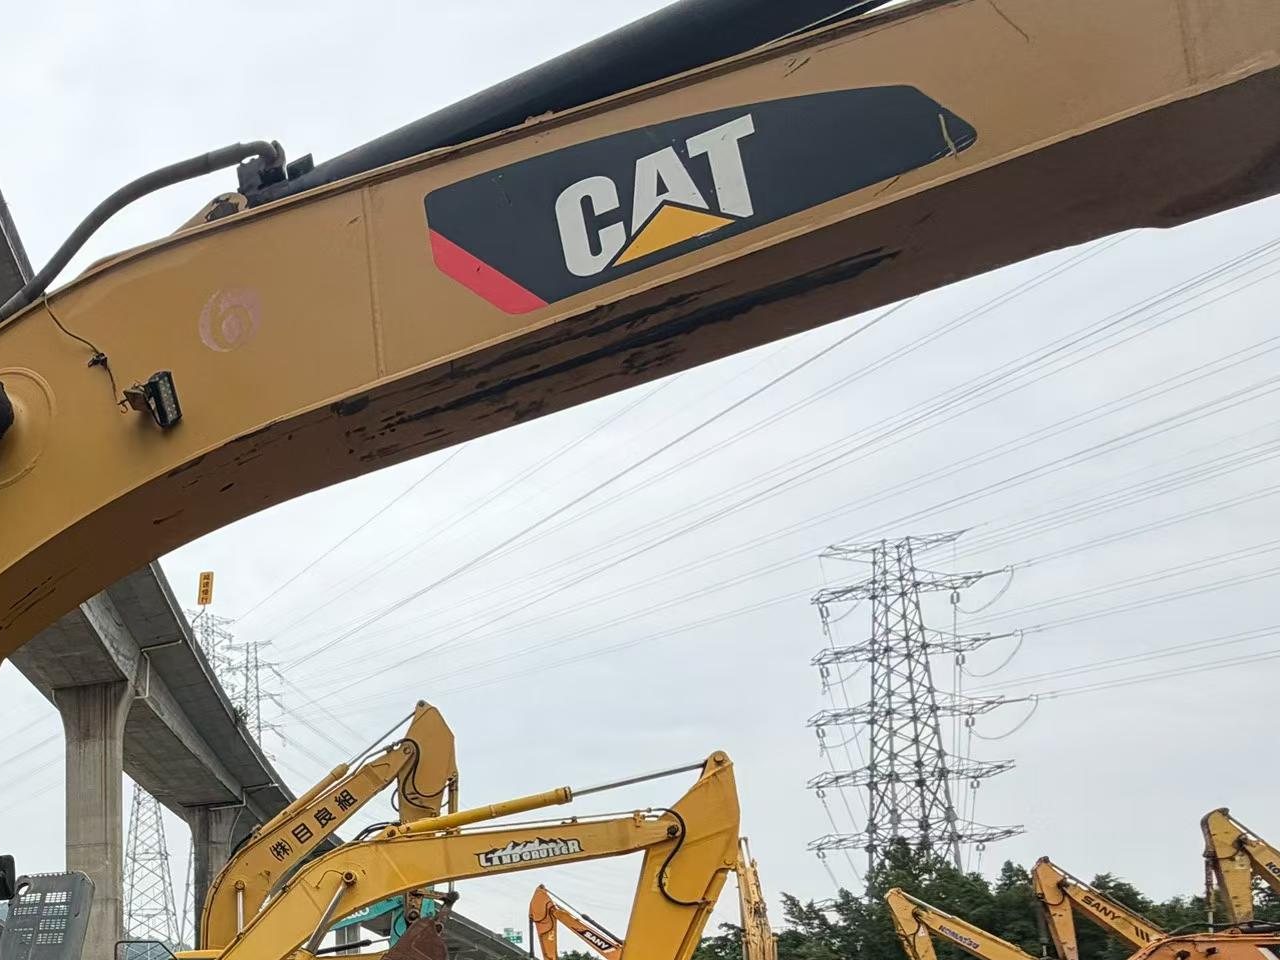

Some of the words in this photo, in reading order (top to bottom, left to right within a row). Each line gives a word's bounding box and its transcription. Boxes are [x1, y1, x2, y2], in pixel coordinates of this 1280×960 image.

[555, 113, 755, 277] CAT
[1081, 896, 1121, 920] SANY
[584, 931, 609, 949] SANY
[939, 925, 979, 949] KOMATSU
